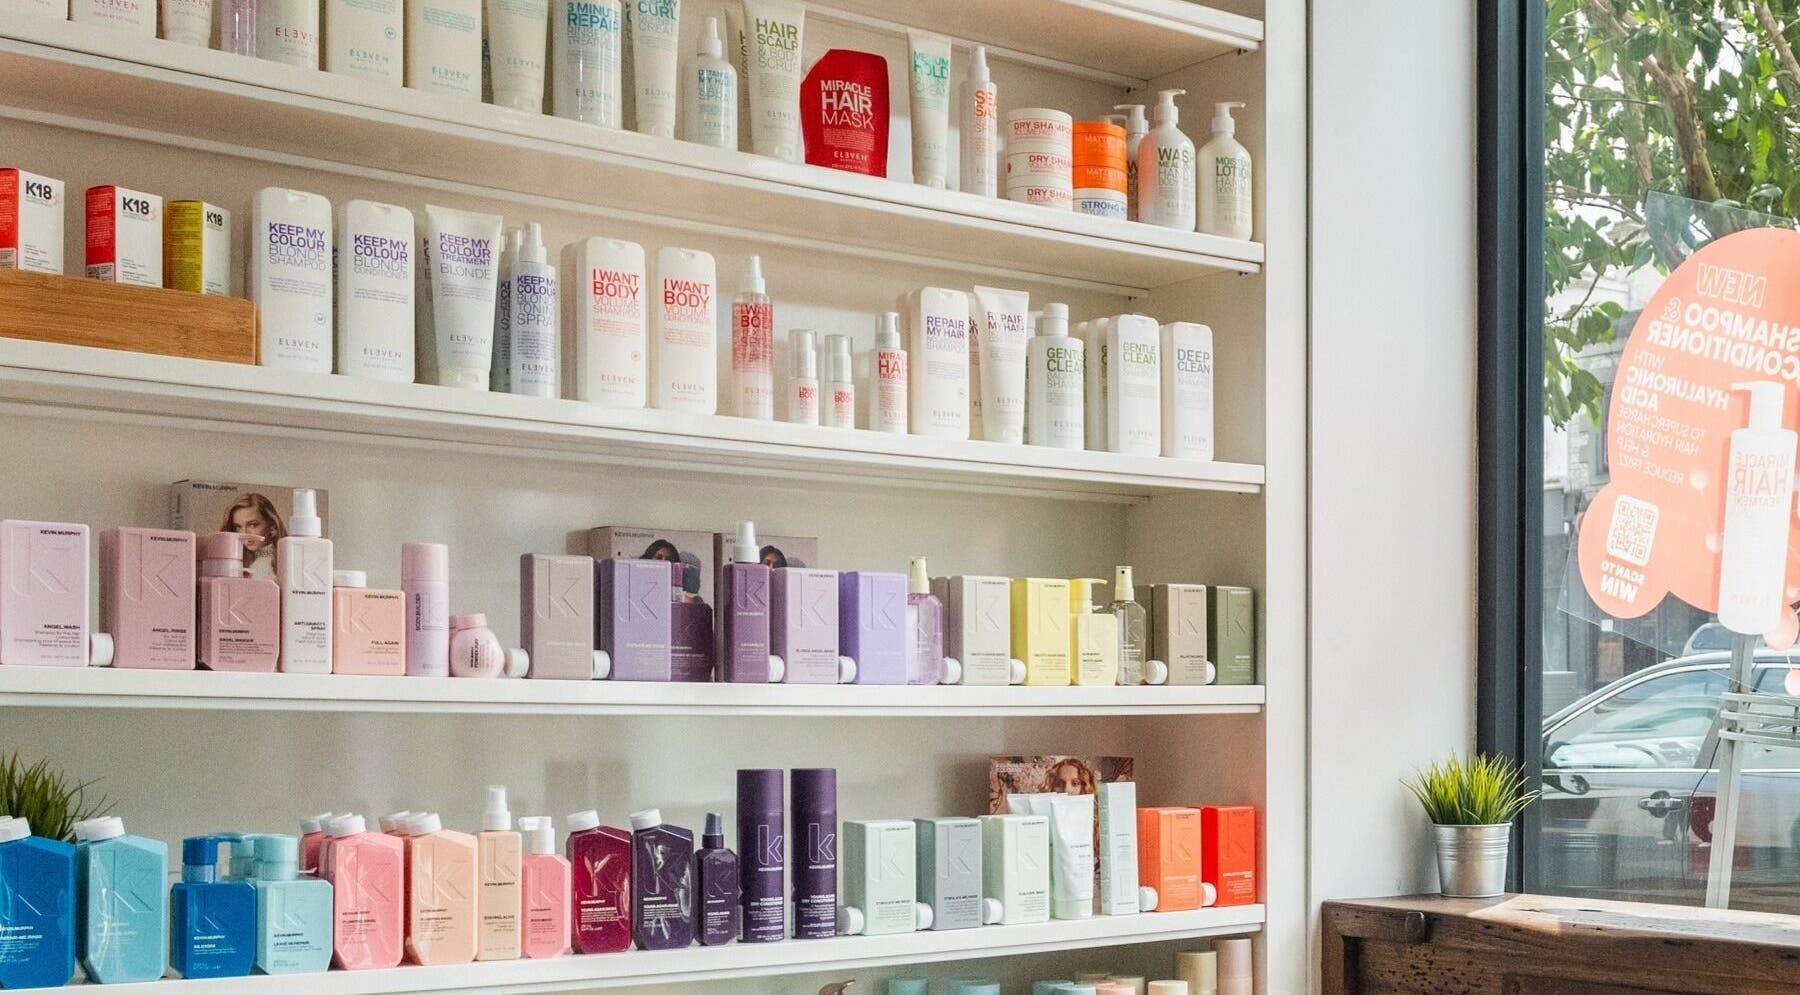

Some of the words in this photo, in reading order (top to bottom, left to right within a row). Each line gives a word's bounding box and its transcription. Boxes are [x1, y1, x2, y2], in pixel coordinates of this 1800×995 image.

[637, 0, 676, 20] CURL
[567, 13, 619, 32] REPAIR
[755, 17, 799, 40] HAIR
[757, 33, 800, 51] SCALP
[820, 79, 873, 98] MIRACLE
[820, 91, 873, 115] HAIR
[821, 110, 875, 131] MASK
[1013, 121, 1031, 131] DRY
[1028, 154, 1049, 163] DRY
[25, 180, 52, 200] K18
[1026, 188, 1048, 197] DRY
[122, 196, 150, 216] K18
[1081, 200, 1120, 213] STRONG
[205, 210, 223, 228] K18
[268, 222, 304, 236] KEEP
[305, 228, 326, 240] MY
[268, 233, 326, 251] COLOUR
[354, 234, 388, 247] KEEP
[389, 238, 408, 251] MY
[439, 232, 470, 245] KEEP
[470, 238, 490, 249] MY
[268, 243, 325, 262] BLONDE
[354, 245, 408, 262] COLOUR
[439, 243, 490, 259] COLOUR
[440, 252, 491, 267] TREATMENT
[268, 255, 327, 272] SHAMPOO
[354, 256, 408, 273] BLONDE
[440, 264, 492, 281] BLONDE
[517, 275, 544, 286] KEEP
[599, 269, 640, 287] WANT
[592, 279, 640, 299] BODY
[670, 279, 711, 296] WANT
[664, 289, 711, 309] BODY
[926, 315, 965, 330] REPAIR
[926, 326, 941, 338] MY
[943, 327, 965, 340] HAIR
[278, 336, 320, 350] ELEVEN
[1122, 341, 1157, 354] GENTLE
[1122, 351, 1157, 366] CLEAN
[1176, 347, 1210, 363] DEEP
[1176, 360, 1211, 375] CLEAN
[40, 529, 82, 537] KEVIN.MURPHY
